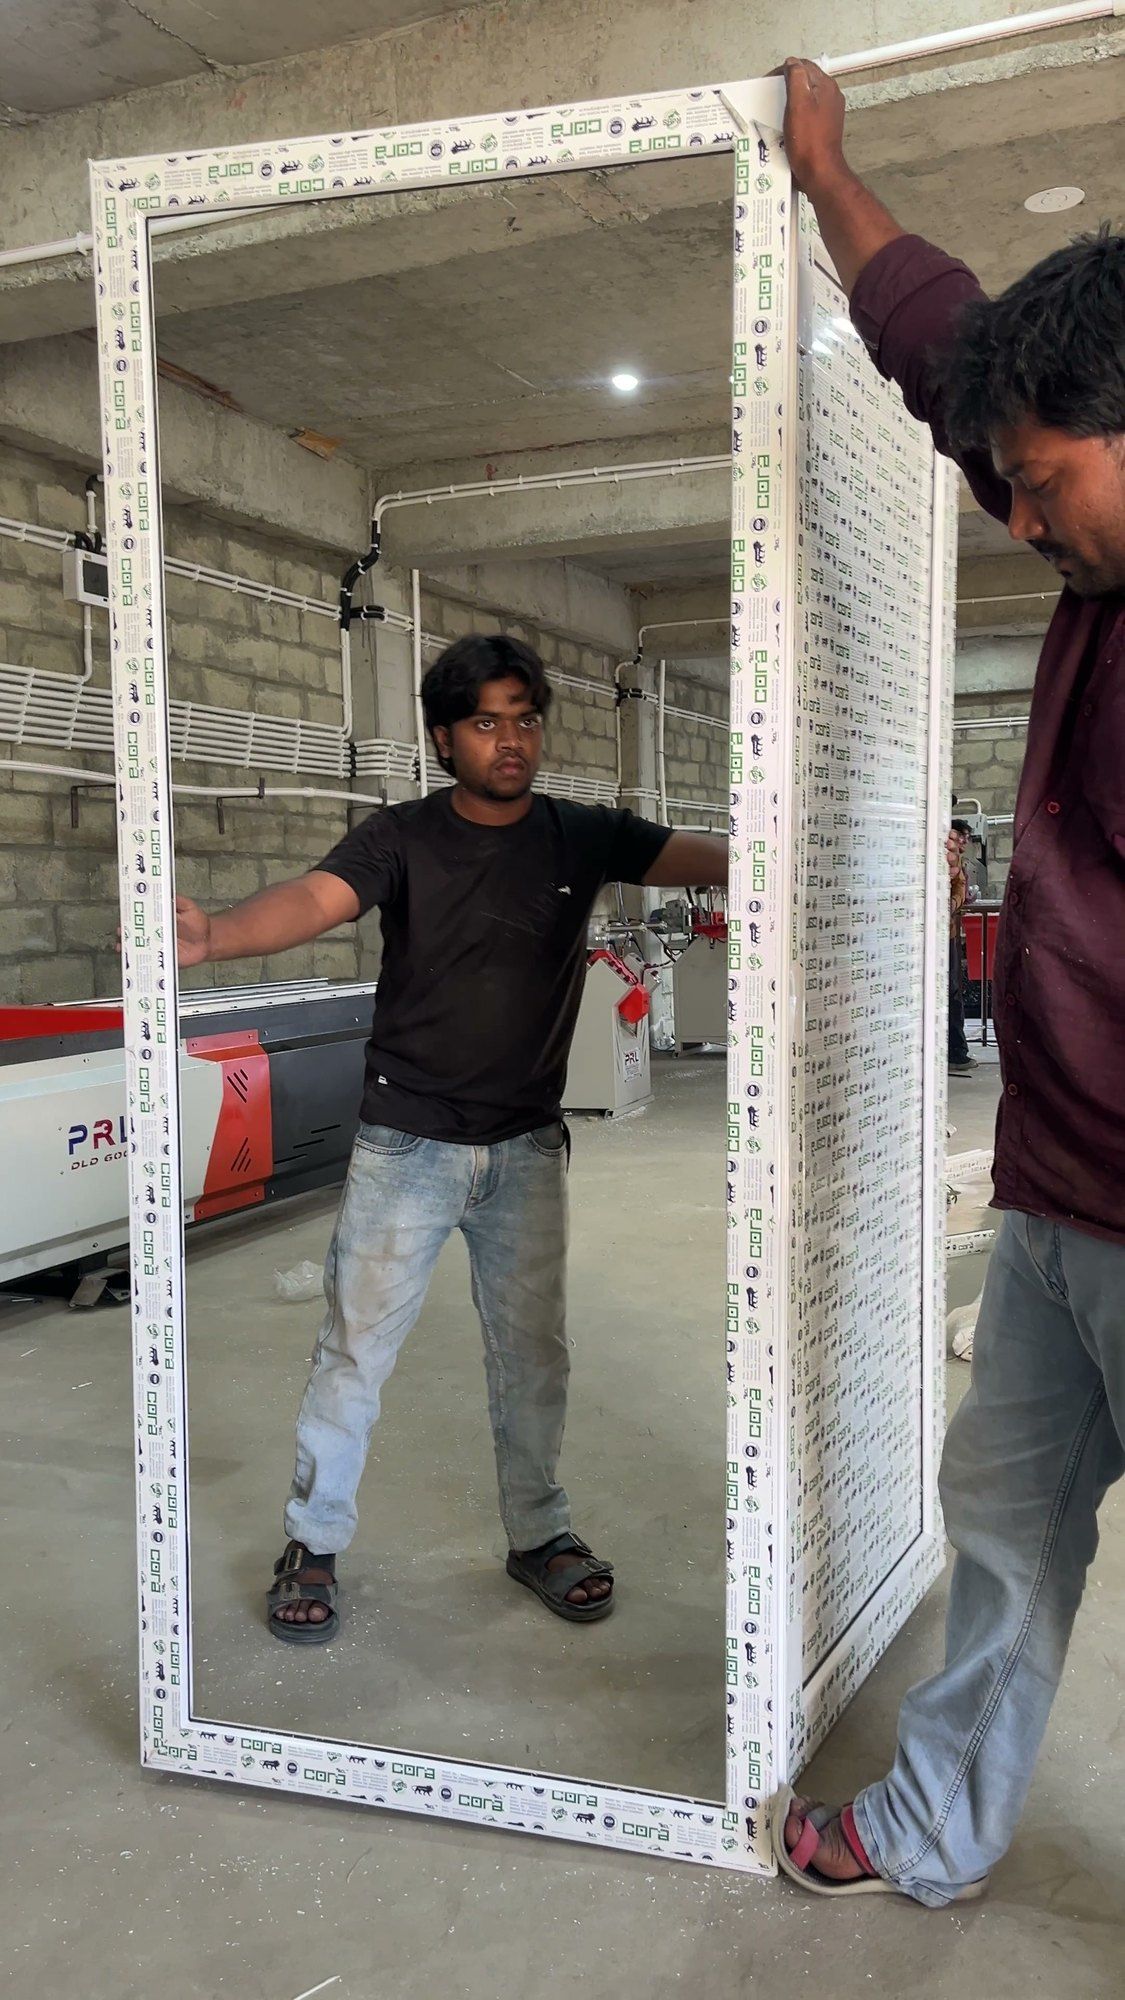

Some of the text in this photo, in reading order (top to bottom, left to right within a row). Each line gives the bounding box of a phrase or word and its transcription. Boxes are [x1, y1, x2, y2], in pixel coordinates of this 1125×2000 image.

[374, 141, 423, 160] cora
[550, 119, 602, 138] cora
[628, 134, 682, 154] cora
[208, 162, 254, 179] cora
[277, 178, 325, 196] cora
[448, 157, 498, 176] cora
[736, 138, 749, 195] cora
[105, 197, 117, 248] cora
[759, 254, 772, 310] cora
[130, 301, 142, 352] cora
[733, 342, 747, 397] cora
[114, 380, 126, 429] cora
[757, 454, 770, 509] cora
[138, 482, 150, 531] cora
[121, 558, 133, 606] cora
[732, 538, 745, 593] cora
[144, 657, 156, 705] cora
[754, 650, 768, 703] cora
[127, 731, 139, 779] cora
[730, 732, 743, 785] cora
[150, 829, 161, 877] cora
[752, 840, 766, 892] cora
[133, 901, 145, 948] cora
[728, 919, 741, 971] cora
[156, 997, 167, 1044] cora
[751, 1025, 763, 1077] cora
[139, 1067, 151, 1113] cora
[727, 1102, 740, 1153] cora
[160, 1162, 171, 1208] cora
[143, 1230, 155, 1276] cora
[749, 1208, 762, 1258] cora
[726, 1282, 739, 1333] cora
[164, 1324, 175, 1370] cora
[146, 1391, 158, 1436] cora
[749, 1387, 762, 1438] cora
[167, 1484, 178, 1529] cora
[726, 1461, 739, 1511] cora
[150, 1549, 161, 1593] cora
[748, 1565, 761, 1615] cora
[170, 1641, 180, 1686] cora
[726, 1636, 739, 1686] cora
[240, 1737, 283, 1755] cora
[748, 1740, 761, 1790] cora
[303, 1767, 347, 1786] cora
[391, 1762, 436, 1780] cora
[457, 1793, 505, 1812] cora
[551, 1790, 598, 1807] cora
[622, 1822, 670, 1842] cora
